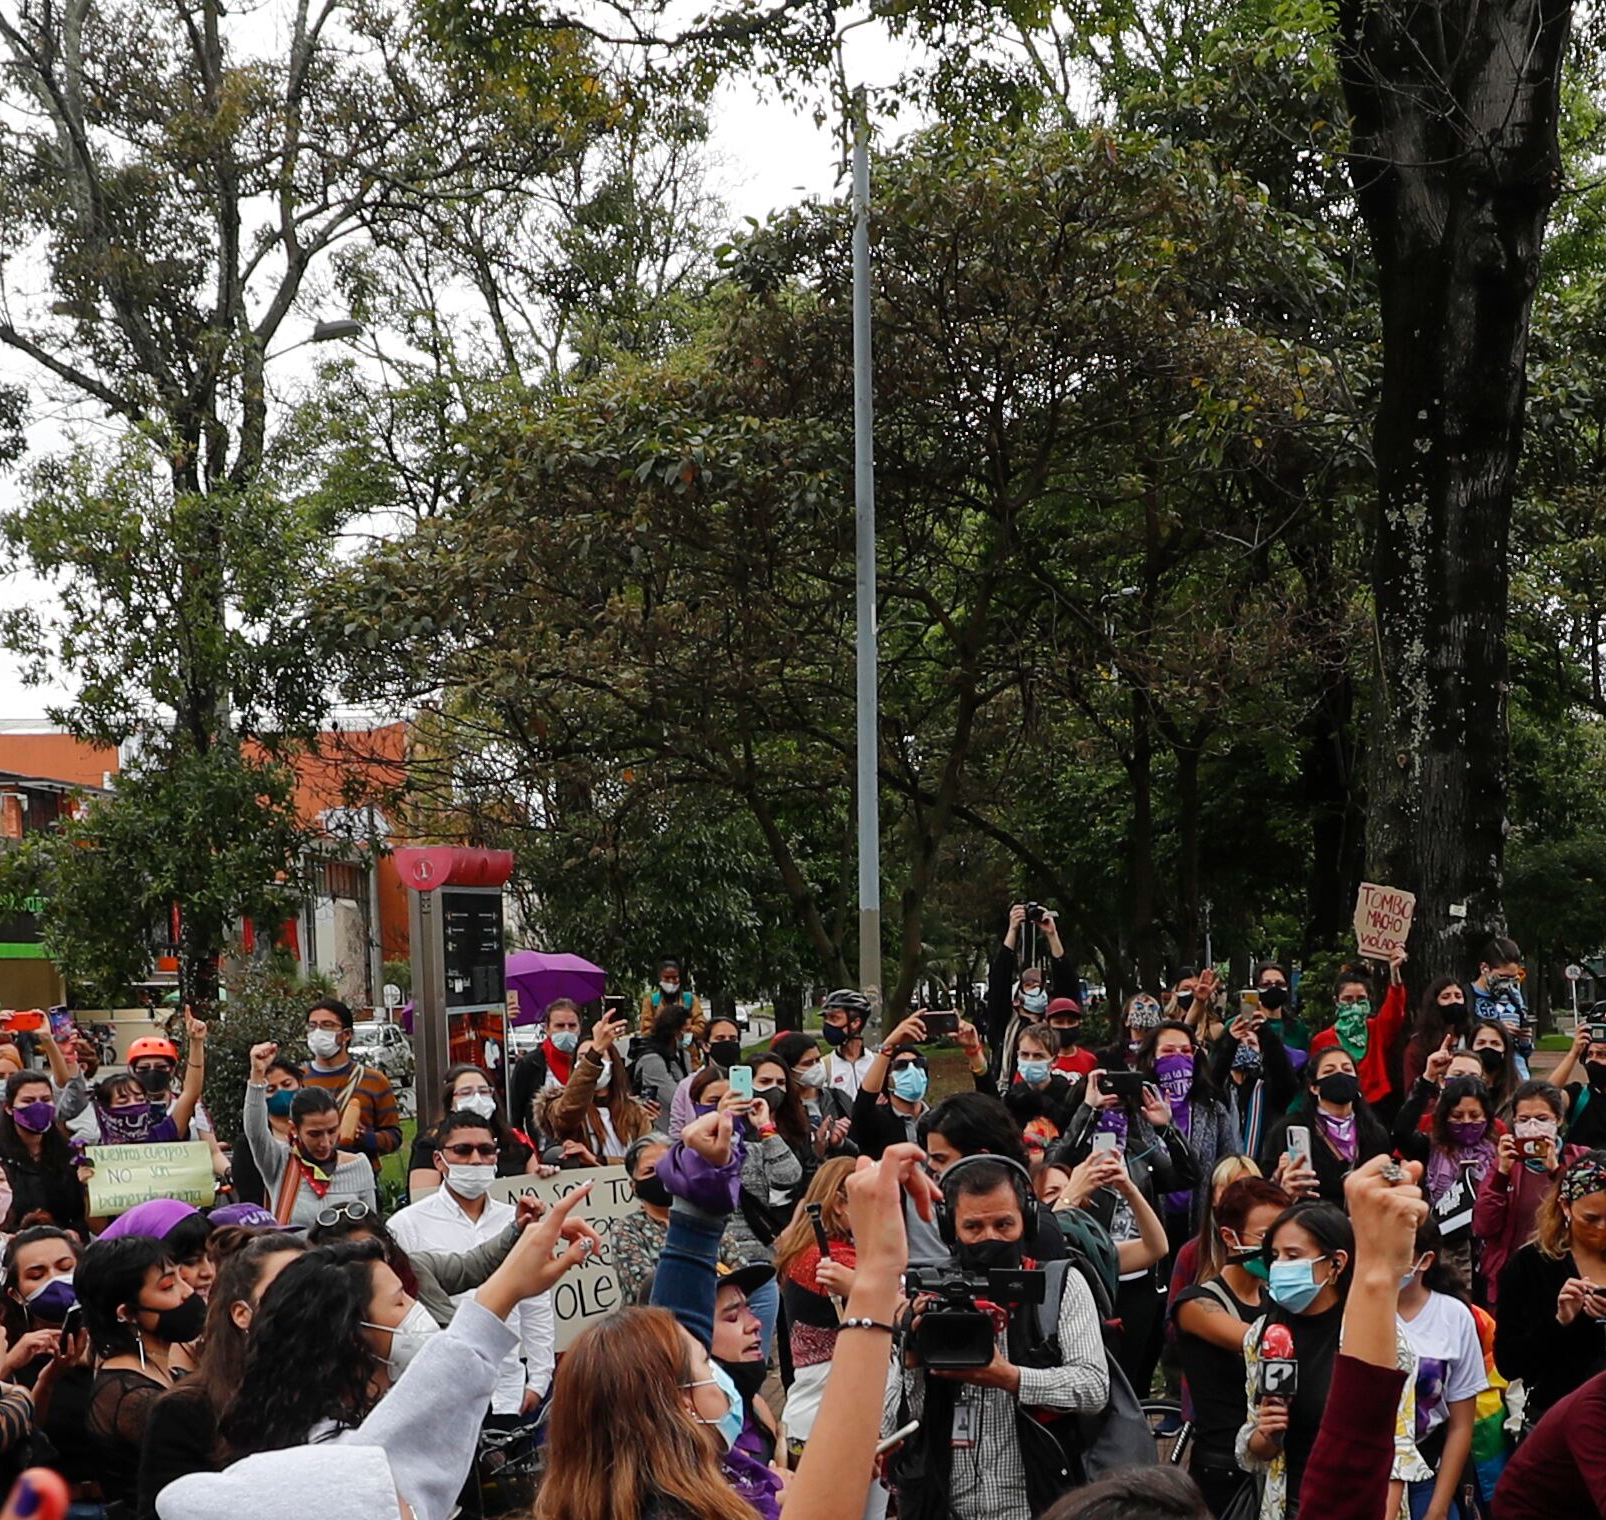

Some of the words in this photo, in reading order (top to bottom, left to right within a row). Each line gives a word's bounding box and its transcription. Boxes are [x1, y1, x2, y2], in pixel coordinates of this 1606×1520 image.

[1362, 886, 1412, 919] TOMBO
[1367, 910, 1402, 933] MACHO
[107, 1167, 133, 1185] NO
[149, 1164, 171, 1179] son
[604, 1178, 634, 1205] TU
